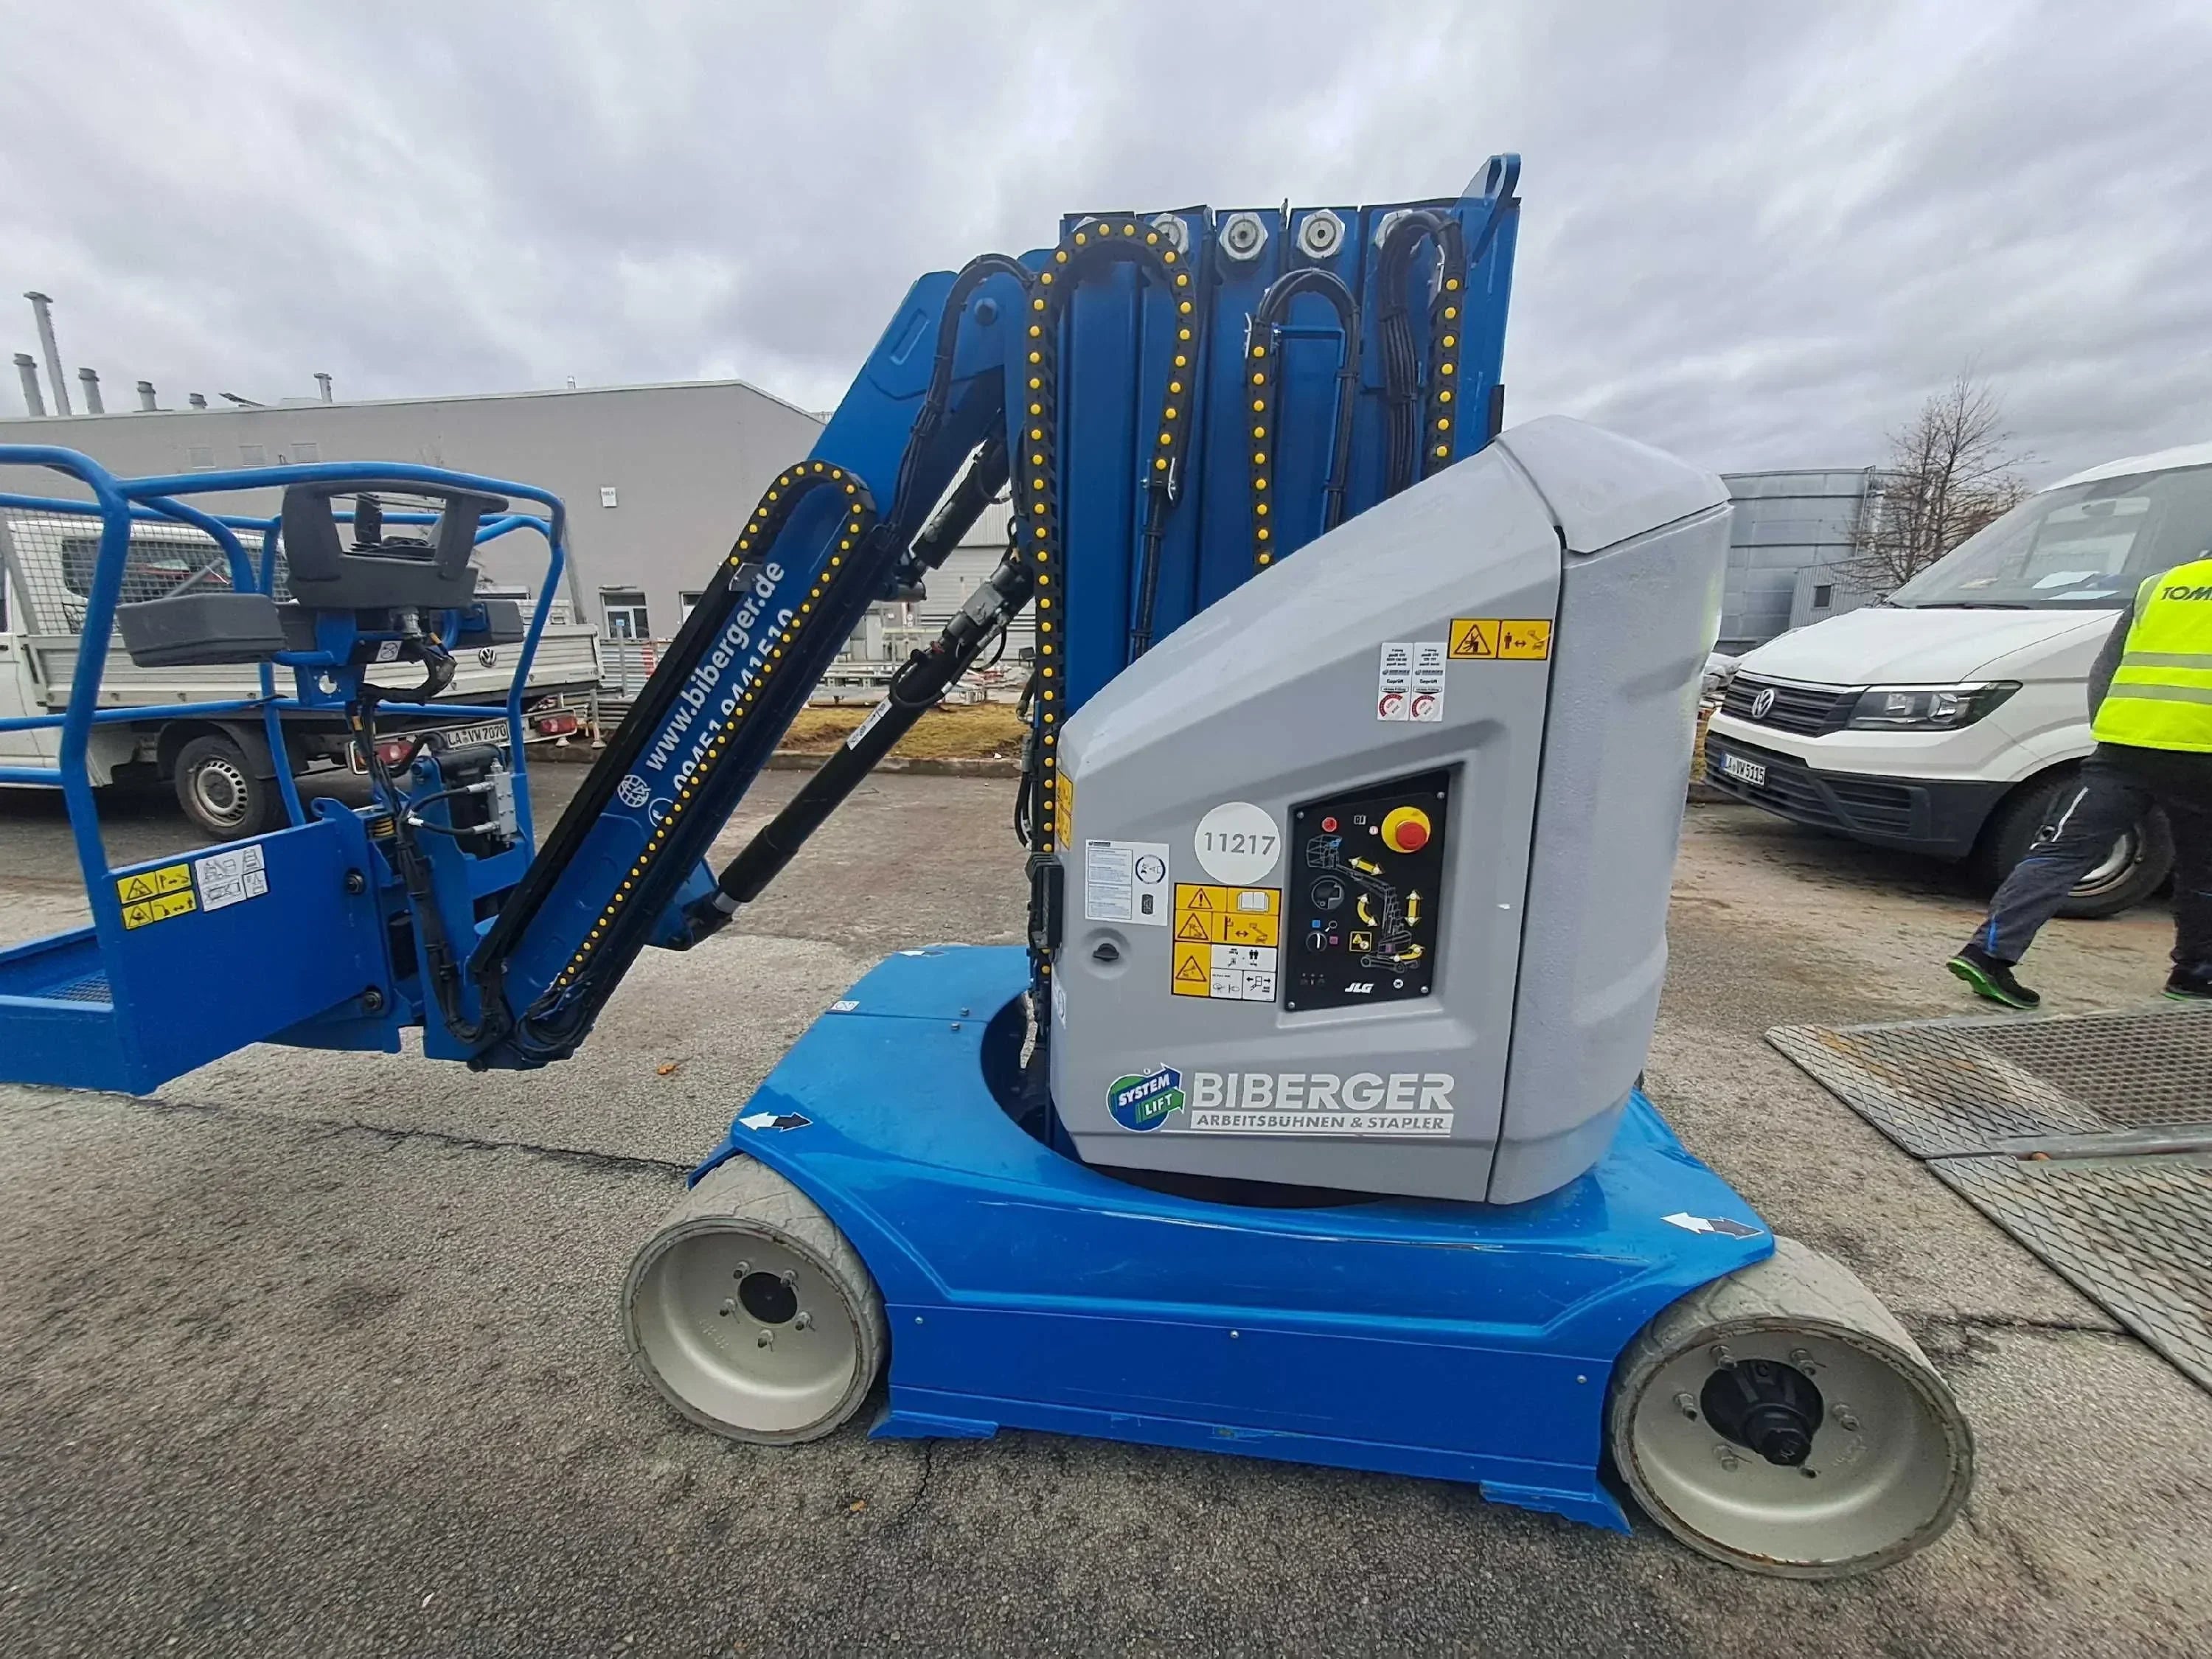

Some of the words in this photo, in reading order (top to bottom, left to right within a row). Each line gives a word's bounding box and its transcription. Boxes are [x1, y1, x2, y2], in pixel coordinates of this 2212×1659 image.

[2160, 585, 2212, 601] TOM
[645, 562, 785, 771] www.biberger.de
[1204, 832, 1276, 855] 11217
[1344, 982, 1374, 993] JLG
[1118, 1073, 1171, 1106] SYSTEM
[1192, 1072, 1455, 1111] BIBERGER
[1144, 1093, 1173, 1116] LIFT
[1197, 1114, 1346, 1128] ARBEITSBÜHNEN
[1350, 1116, 1363, 1128] &
[1367, 1116, 1444, 1130] STAPLER
